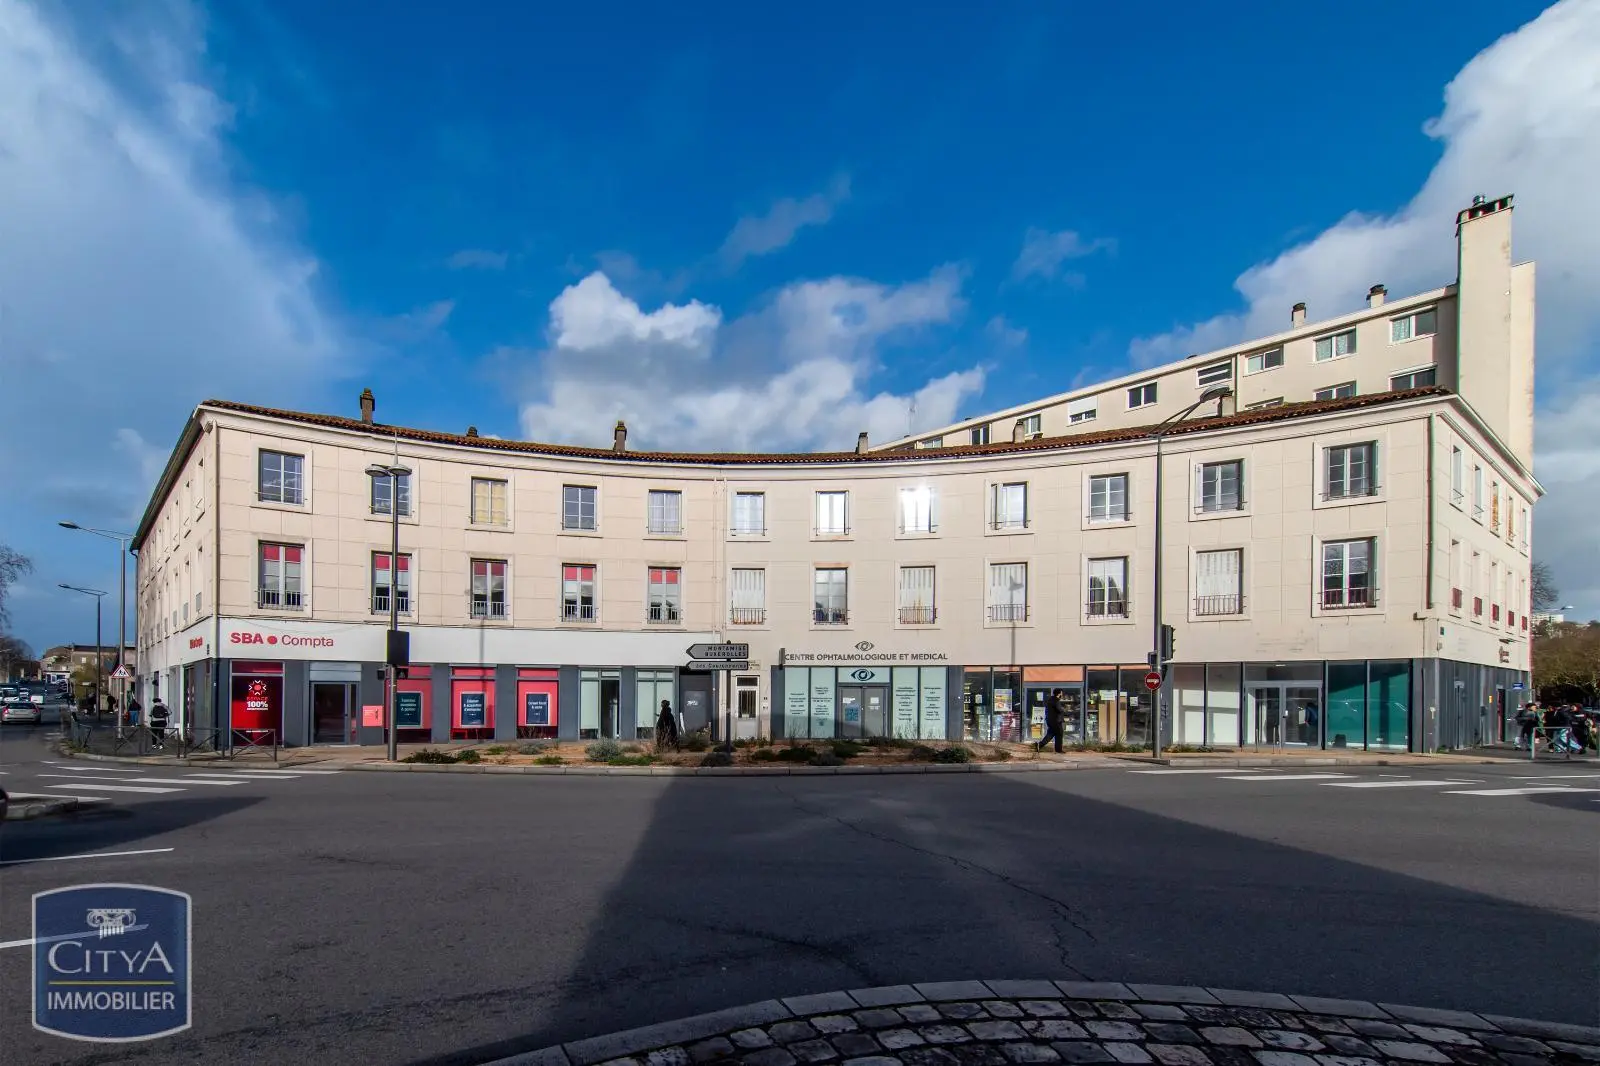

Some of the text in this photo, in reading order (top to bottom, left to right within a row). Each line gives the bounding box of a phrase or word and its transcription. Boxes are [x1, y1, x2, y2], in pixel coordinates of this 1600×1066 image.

[230, 632, 334, 648] SBA Compta
[785, 653, 815, 661] CENTRE
[816, 653, 897, 661] OPHTALMOLOGIQUE
[246, 700, 269, 708] 100%
